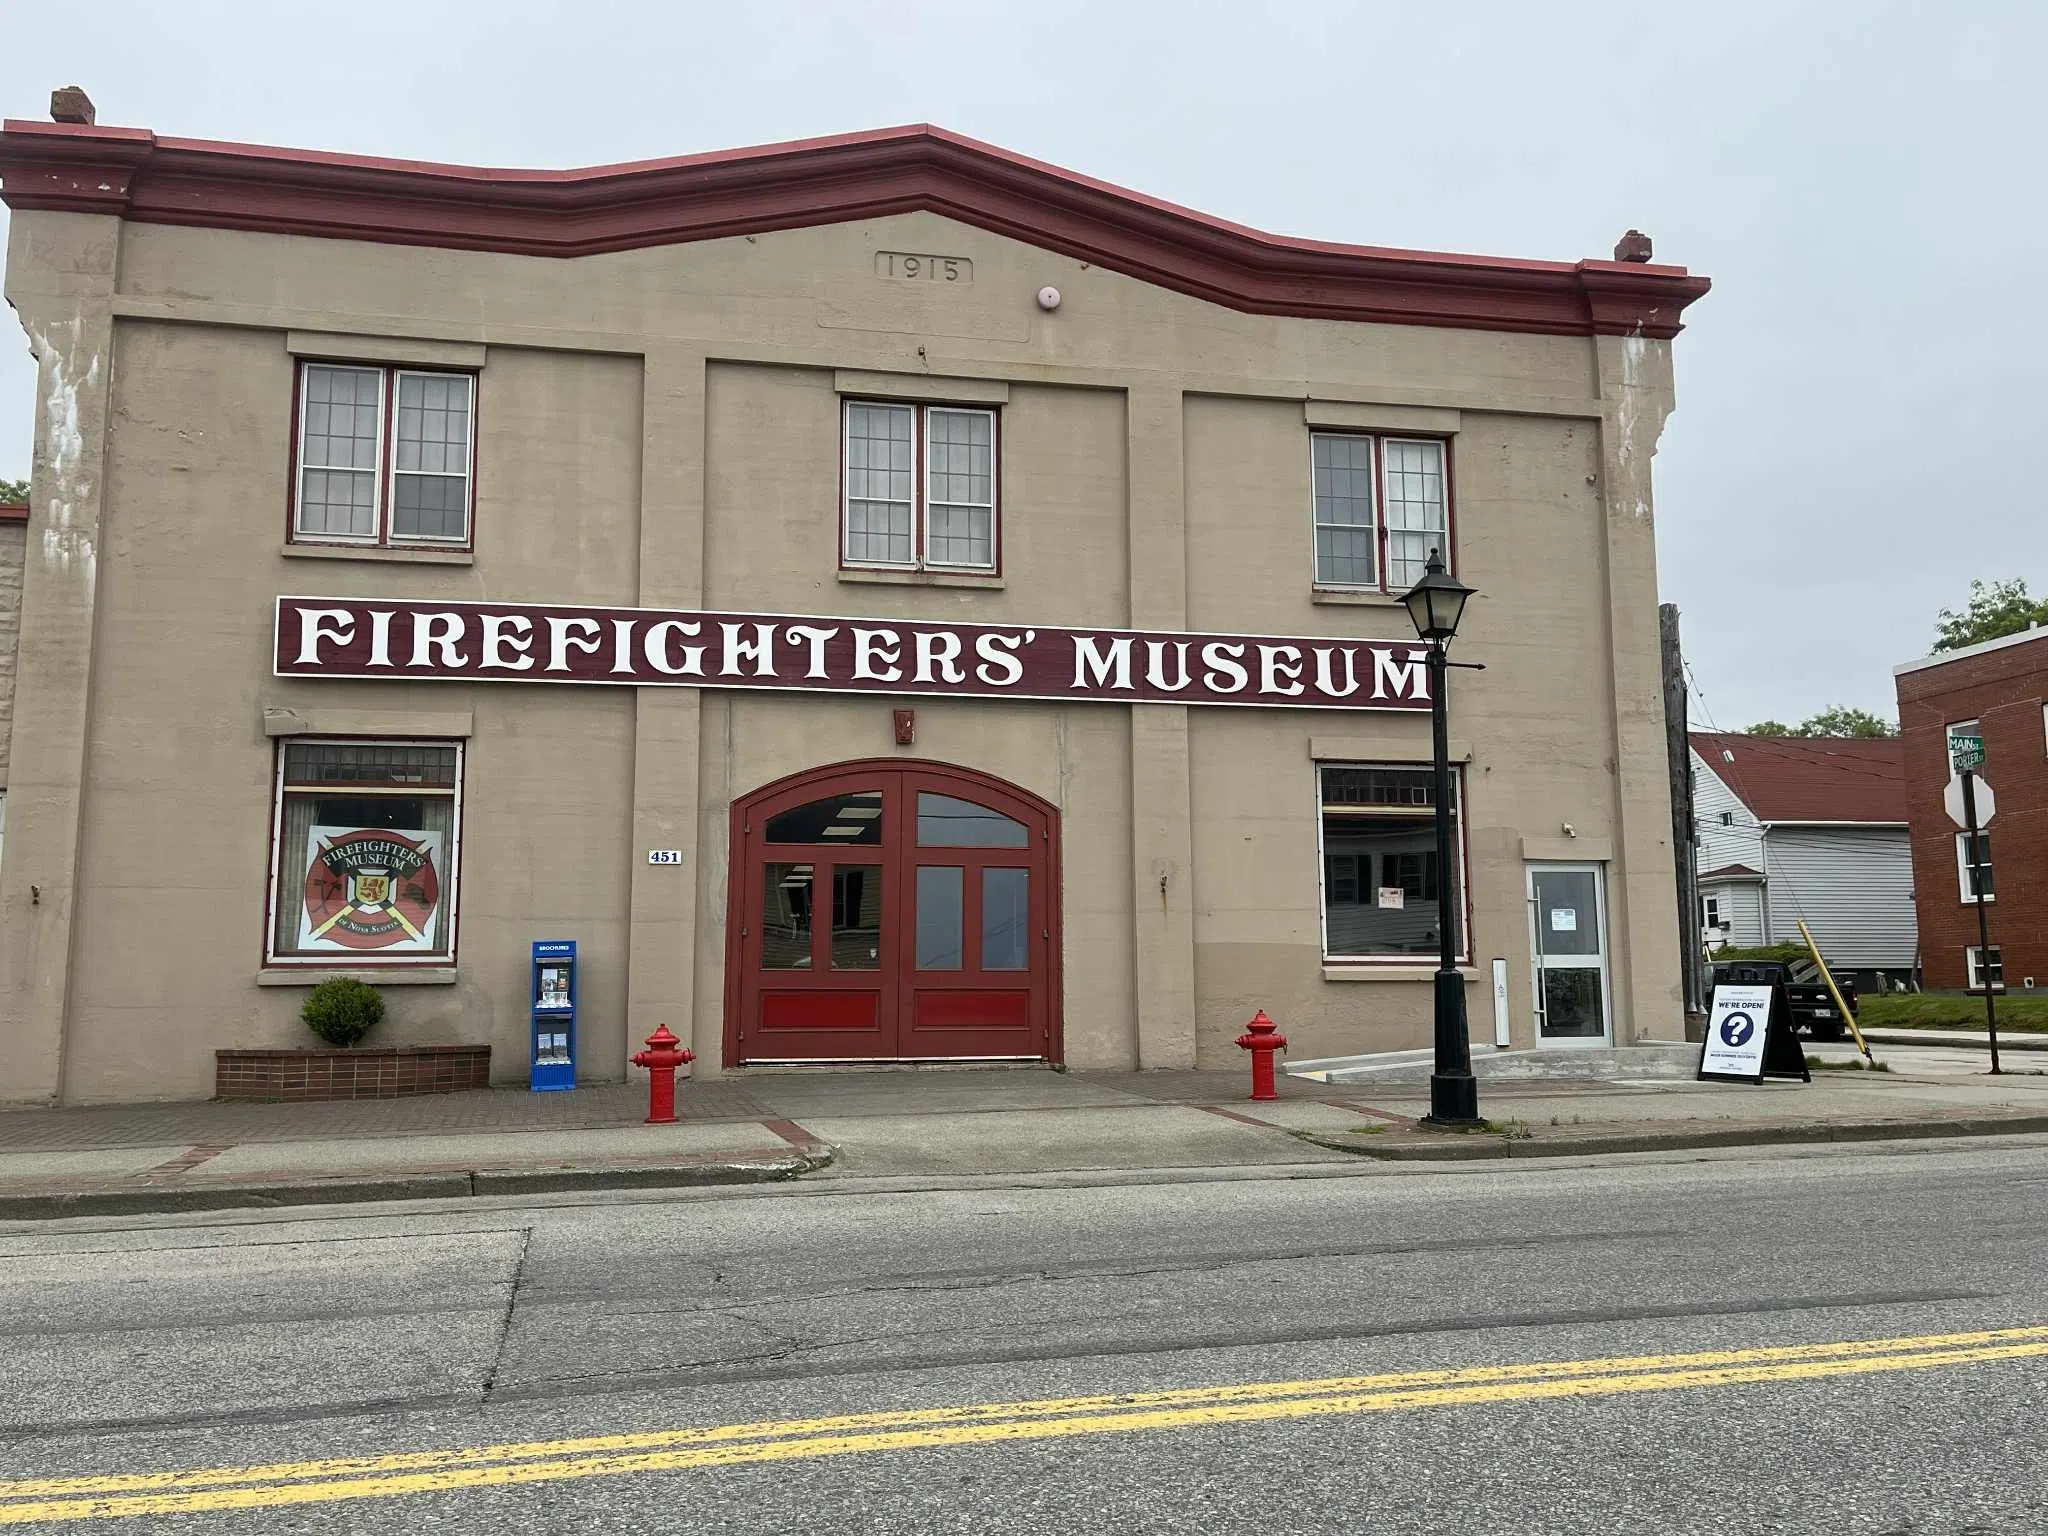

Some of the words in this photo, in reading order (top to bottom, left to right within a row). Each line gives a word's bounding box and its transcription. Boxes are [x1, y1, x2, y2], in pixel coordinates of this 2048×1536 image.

[888, 255, 958, 281] 1915
[292, 607, 1036, 686] FIREFIGHTERS'
[1070, 634, 1434, 701] MUSEUM
[1950, 738, 1973, 749] MAIN
[322, 841, 426, 867] FIREFIGHTERS'
[345, 853, 406, 871] MUSEUM
[650, 851, 679, 863] 451
[1718, 1001, 1741, 1009] WE'RE
